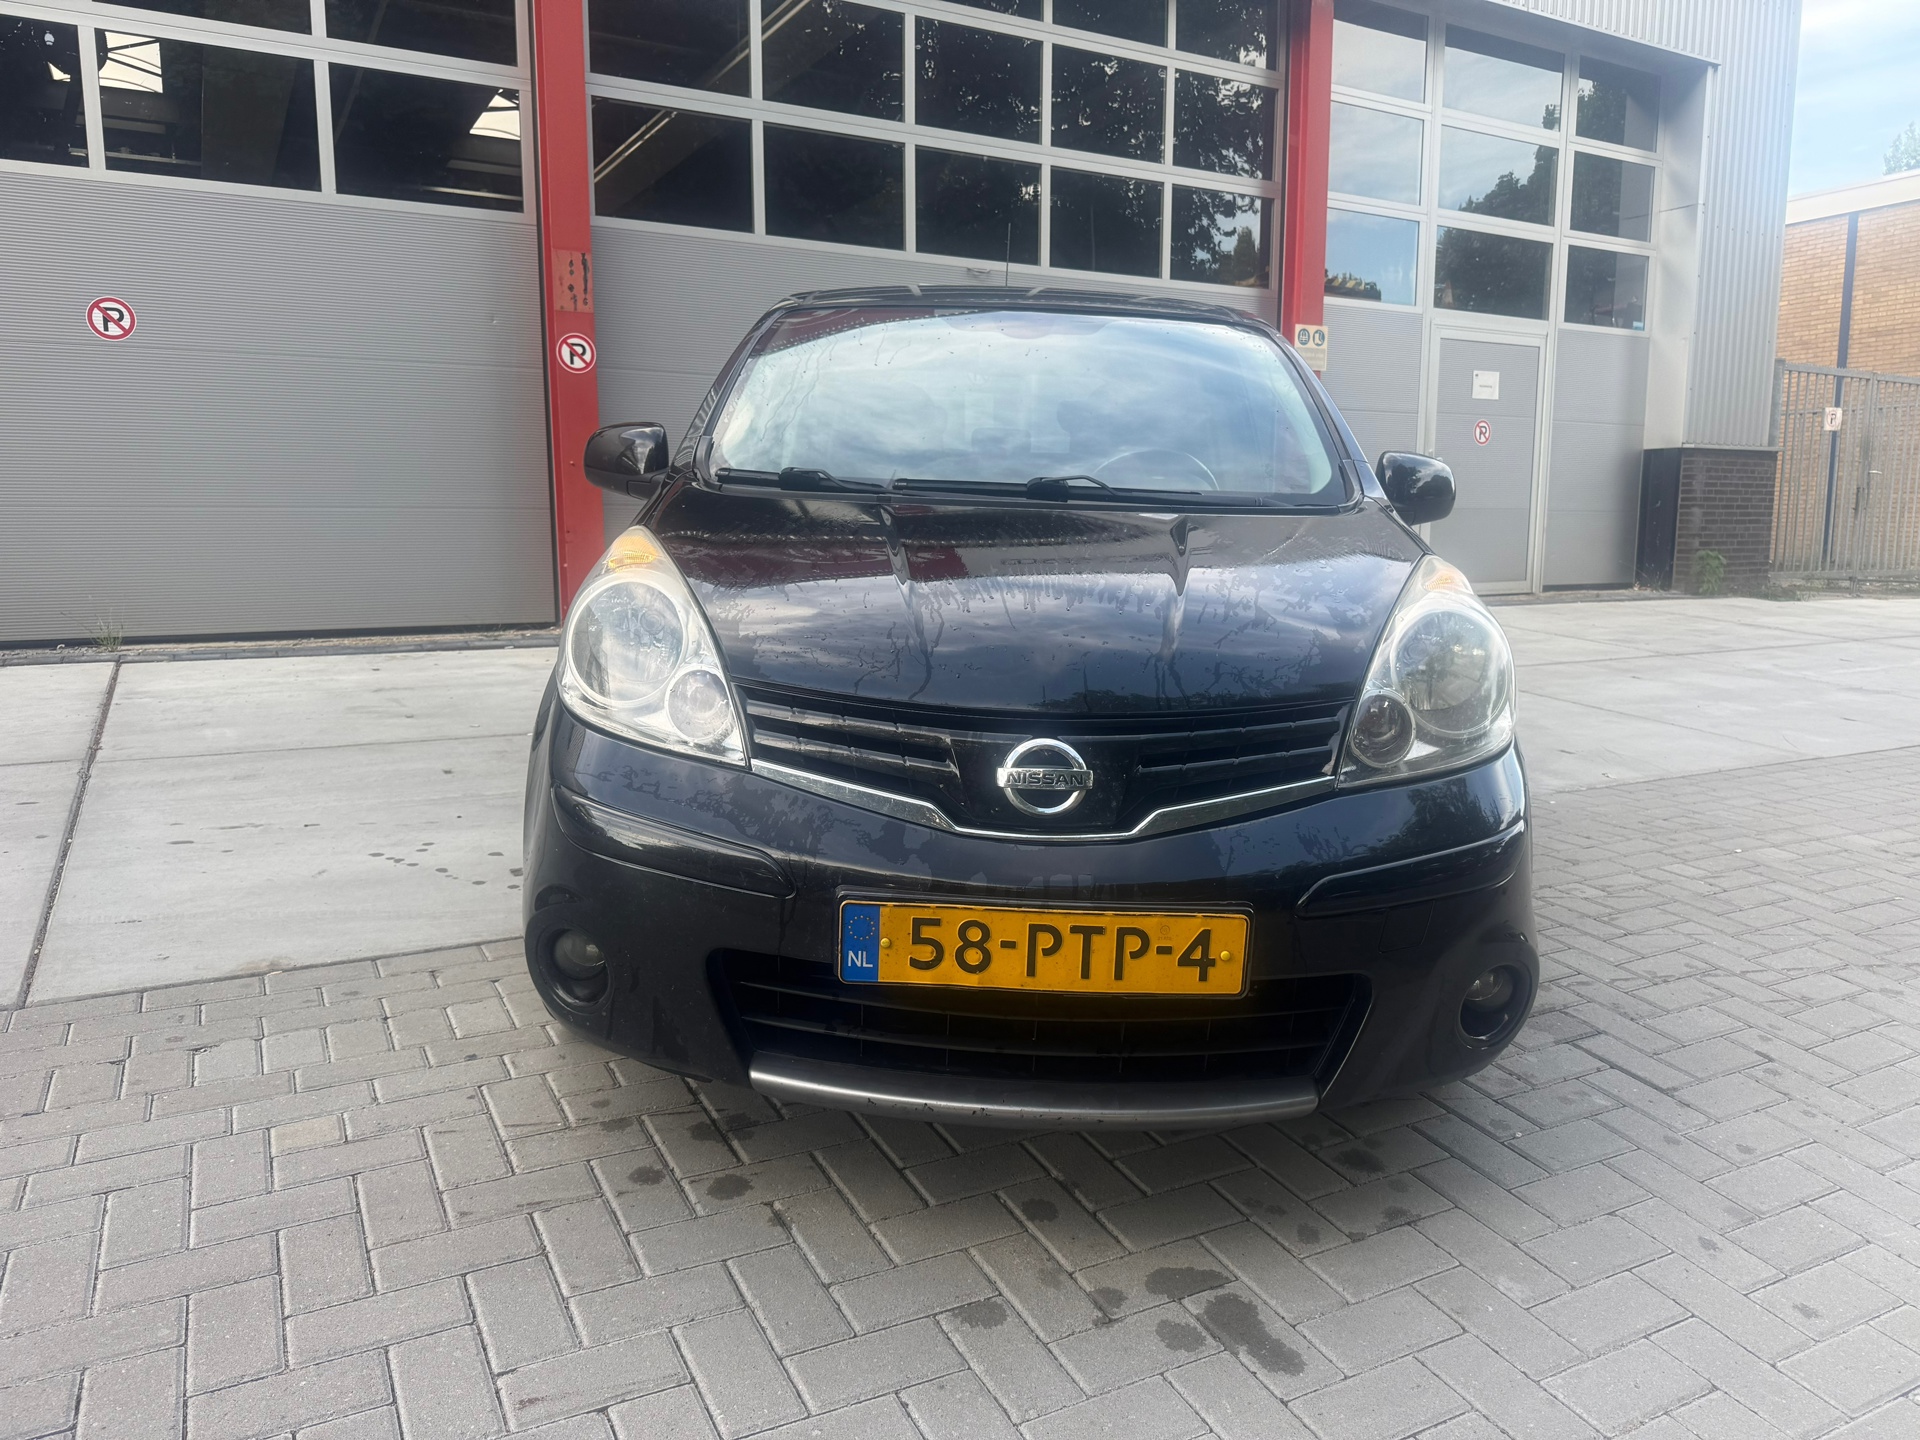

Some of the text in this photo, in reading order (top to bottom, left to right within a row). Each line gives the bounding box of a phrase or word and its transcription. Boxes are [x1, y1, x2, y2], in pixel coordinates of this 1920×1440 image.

[102, 307, 124, 332] P
[569, 343, 587, 365] P
[1006, 772, 1083, 787] NISSAN
[846, 949, 874, 969] NL
[908, 916, 1216, 982] 58-PTP-4
